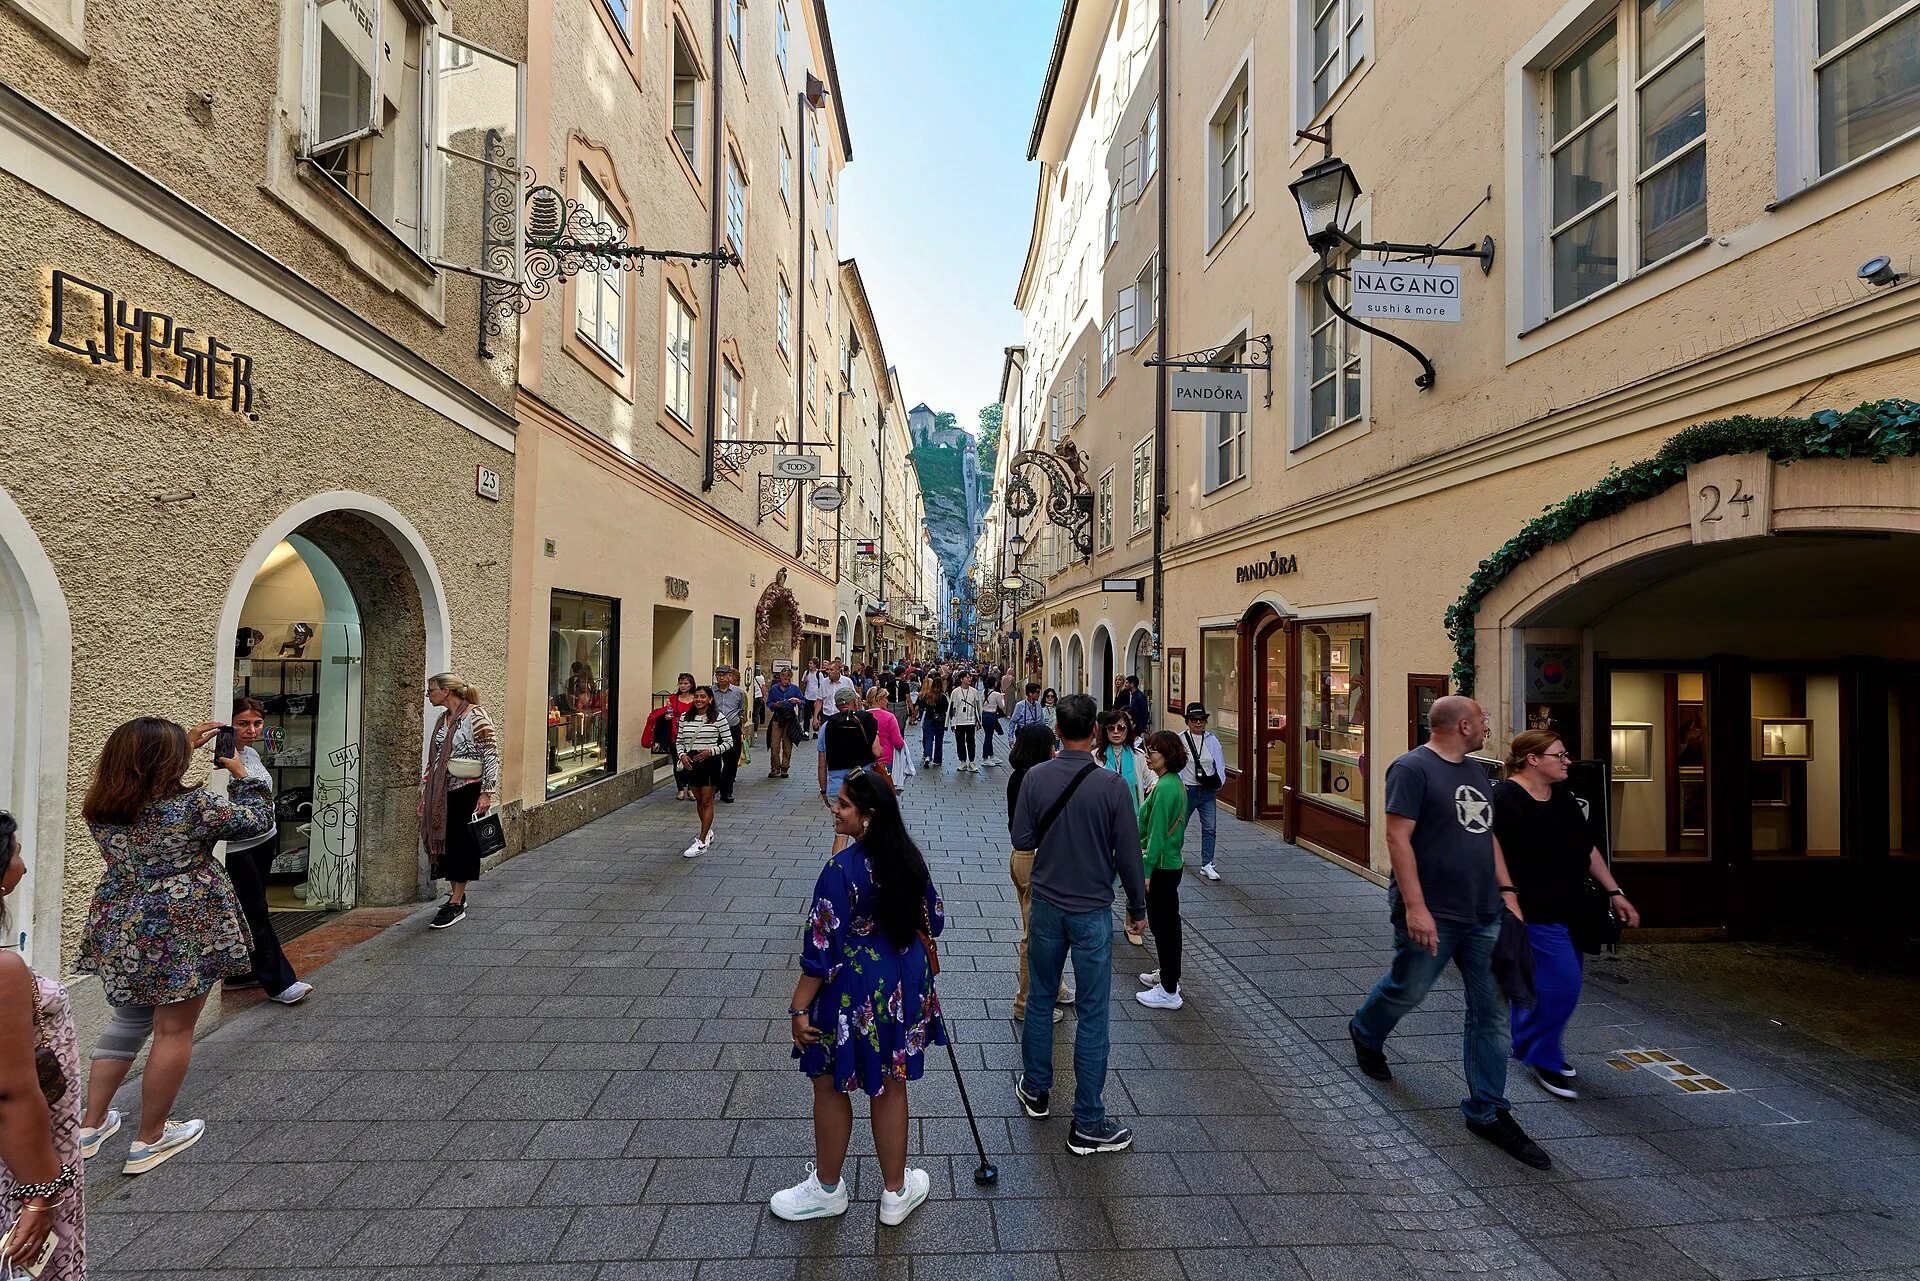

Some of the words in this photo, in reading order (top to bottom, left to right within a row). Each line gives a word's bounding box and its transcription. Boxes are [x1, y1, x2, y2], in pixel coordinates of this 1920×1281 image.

[1358, 275, 1454, 294] NAGANO
[1367, 304, 1400, 313] sushi
[1404, 304, 1411, 314] &
[1416, 306, 1445, 315] more
[1176, 385, 1243, 400] PANDORA
[482, 470, 495, 489] 23
[1699, 479, 1754, 523] 24
[1236, 551, 1298, 583] PANDORA
